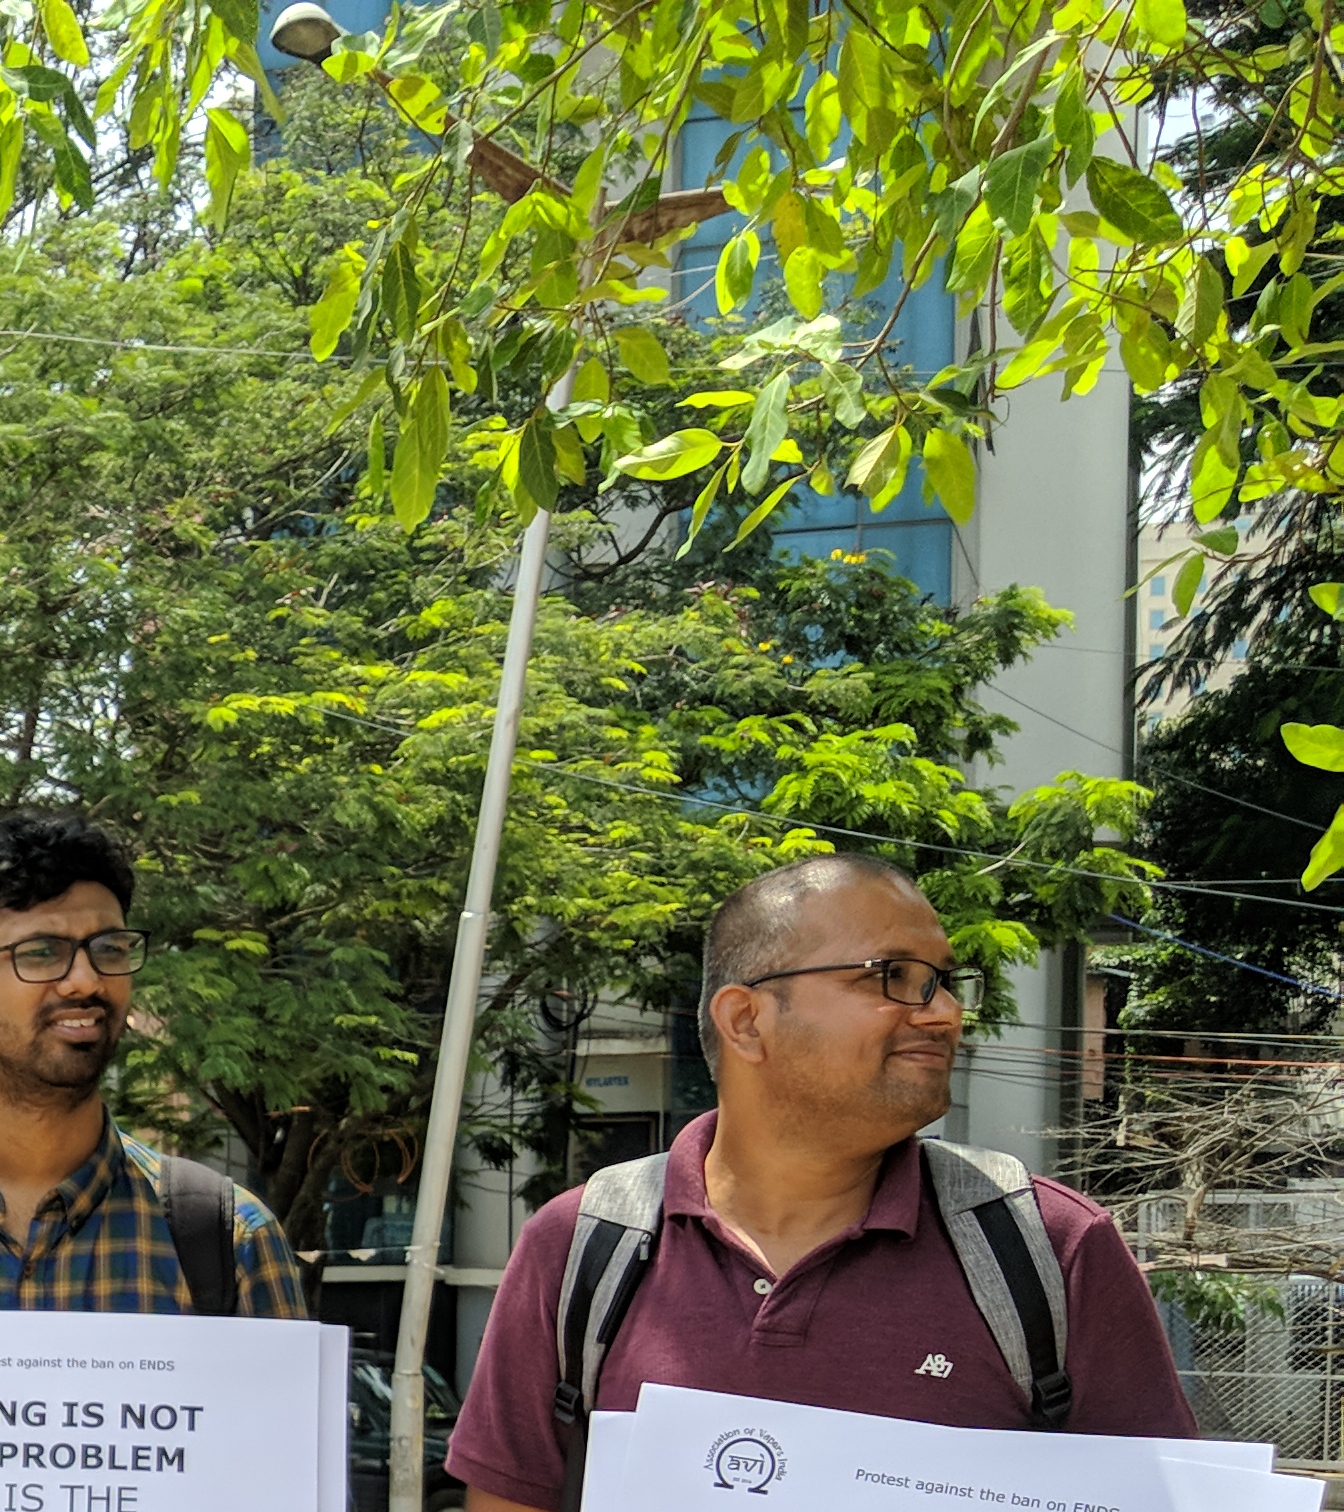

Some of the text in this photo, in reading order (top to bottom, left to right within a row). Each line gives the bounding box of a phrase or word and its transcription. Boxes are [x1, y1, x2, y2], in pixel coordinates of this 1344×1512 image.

[16, 1357, 62, 1369] against
[66, 1357, 87, 1369] the
[91, 1358, 114, 1369] ban
[118, 1360, 134, 1370] on
[139, 1359, 175, 1372] ENDS
[61, 1401, 104, 1428] IS
[120, 1403, 204, 1431] NOT
[703, 1428, 788, 1480] Association of Vapers India
[4, 1483, 44, 1512] IS
[855, 1468, 911, 1489] Protest
[914, 1480, 974, 1498] against
[979, 1488, 1006, 1503] the
[1010, 1492, 1040, 1508] ban
[1046, 1500, 1066, 1512] on
